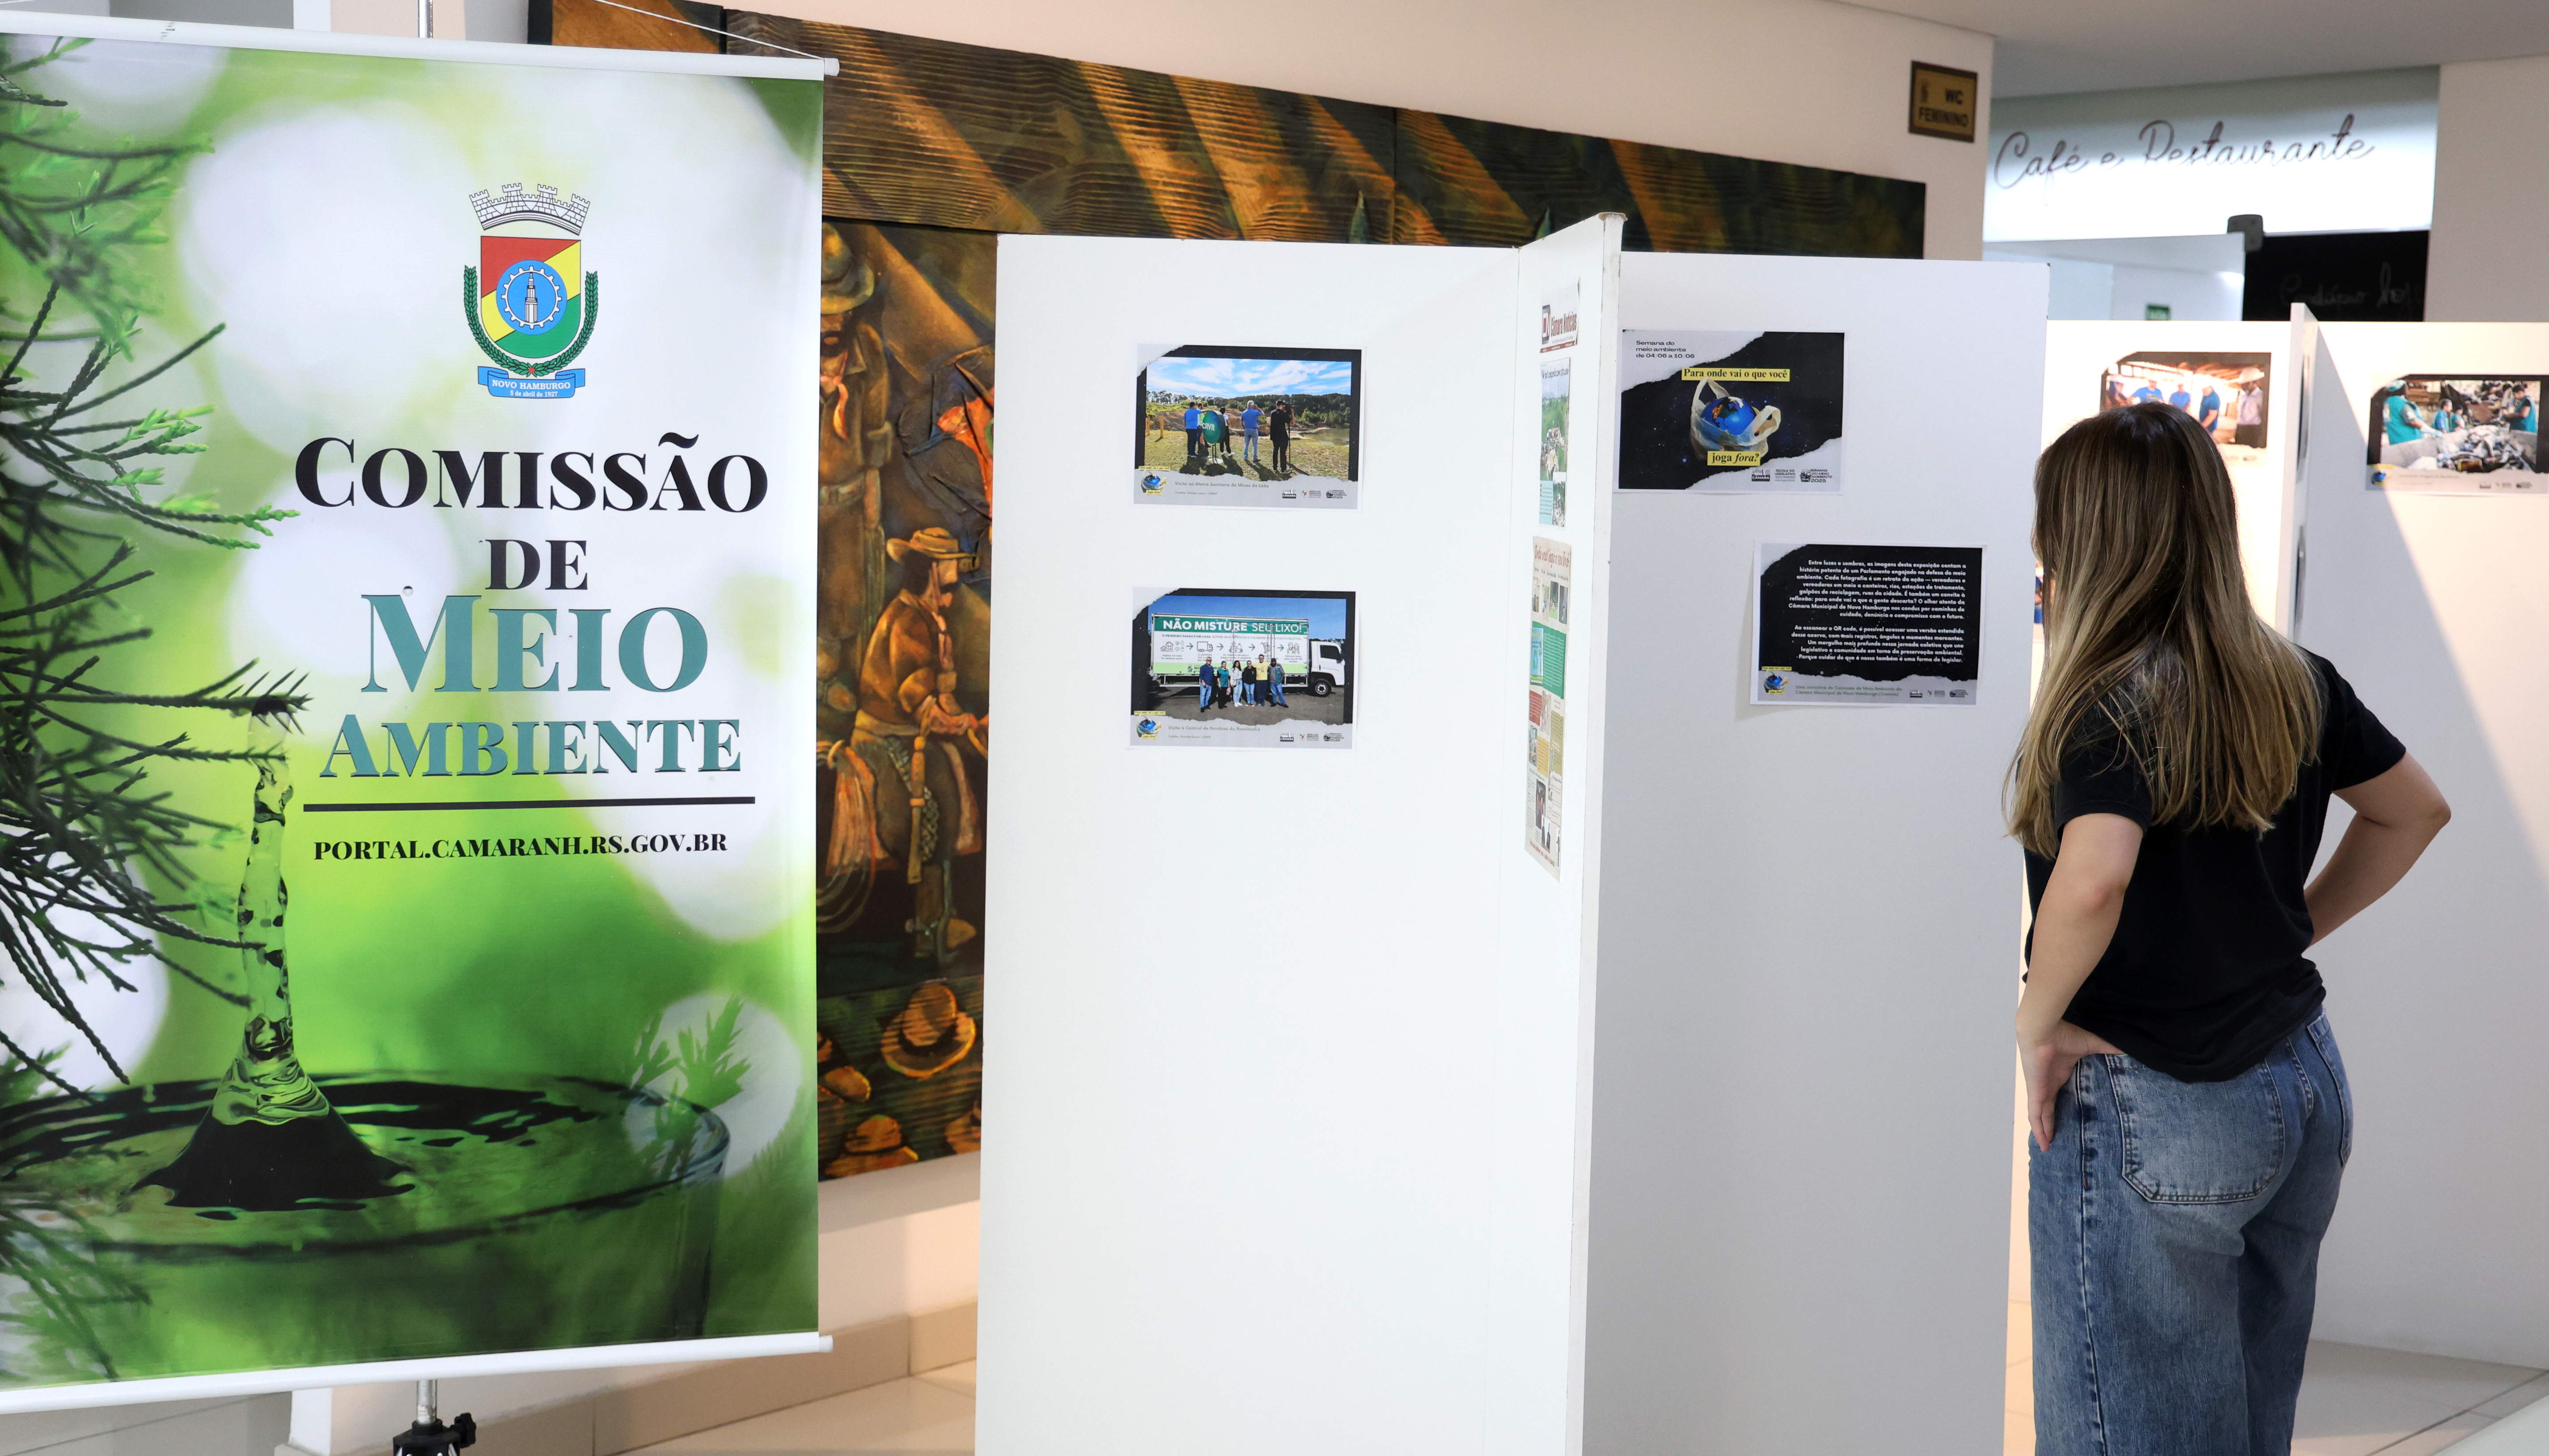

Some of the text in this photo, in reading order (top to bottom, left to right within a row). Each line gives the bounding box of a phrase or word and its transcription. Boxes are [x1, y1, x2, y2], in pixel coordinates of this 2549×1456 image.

[1945, 89, 1964, 105] WC
[1919, 106, 1969, 127] FEMININO
[1994, 131, 2090, 205] Café
[2100, 152, 2125, 171] e
[1684, 369, 1704, 377] Para
[492, 380, 517, 389] NOVO
[1203, 423, 1215, 431] CRVR
[1712, 453, 1759, 464] joga fora?
[295, 431, 768, 513] COMISSÃO
[485, 539, 588, 590] DE
[1163, 618, 1302, 633] NÃO MISTURE SEU LIXO!
[360, 594, 708, 693] MEIO
[319, 714, 741, 778] AMBIENTE
[313, 832, 728, 862] PORTAL.CAMARANH.RS.GOV.BR
